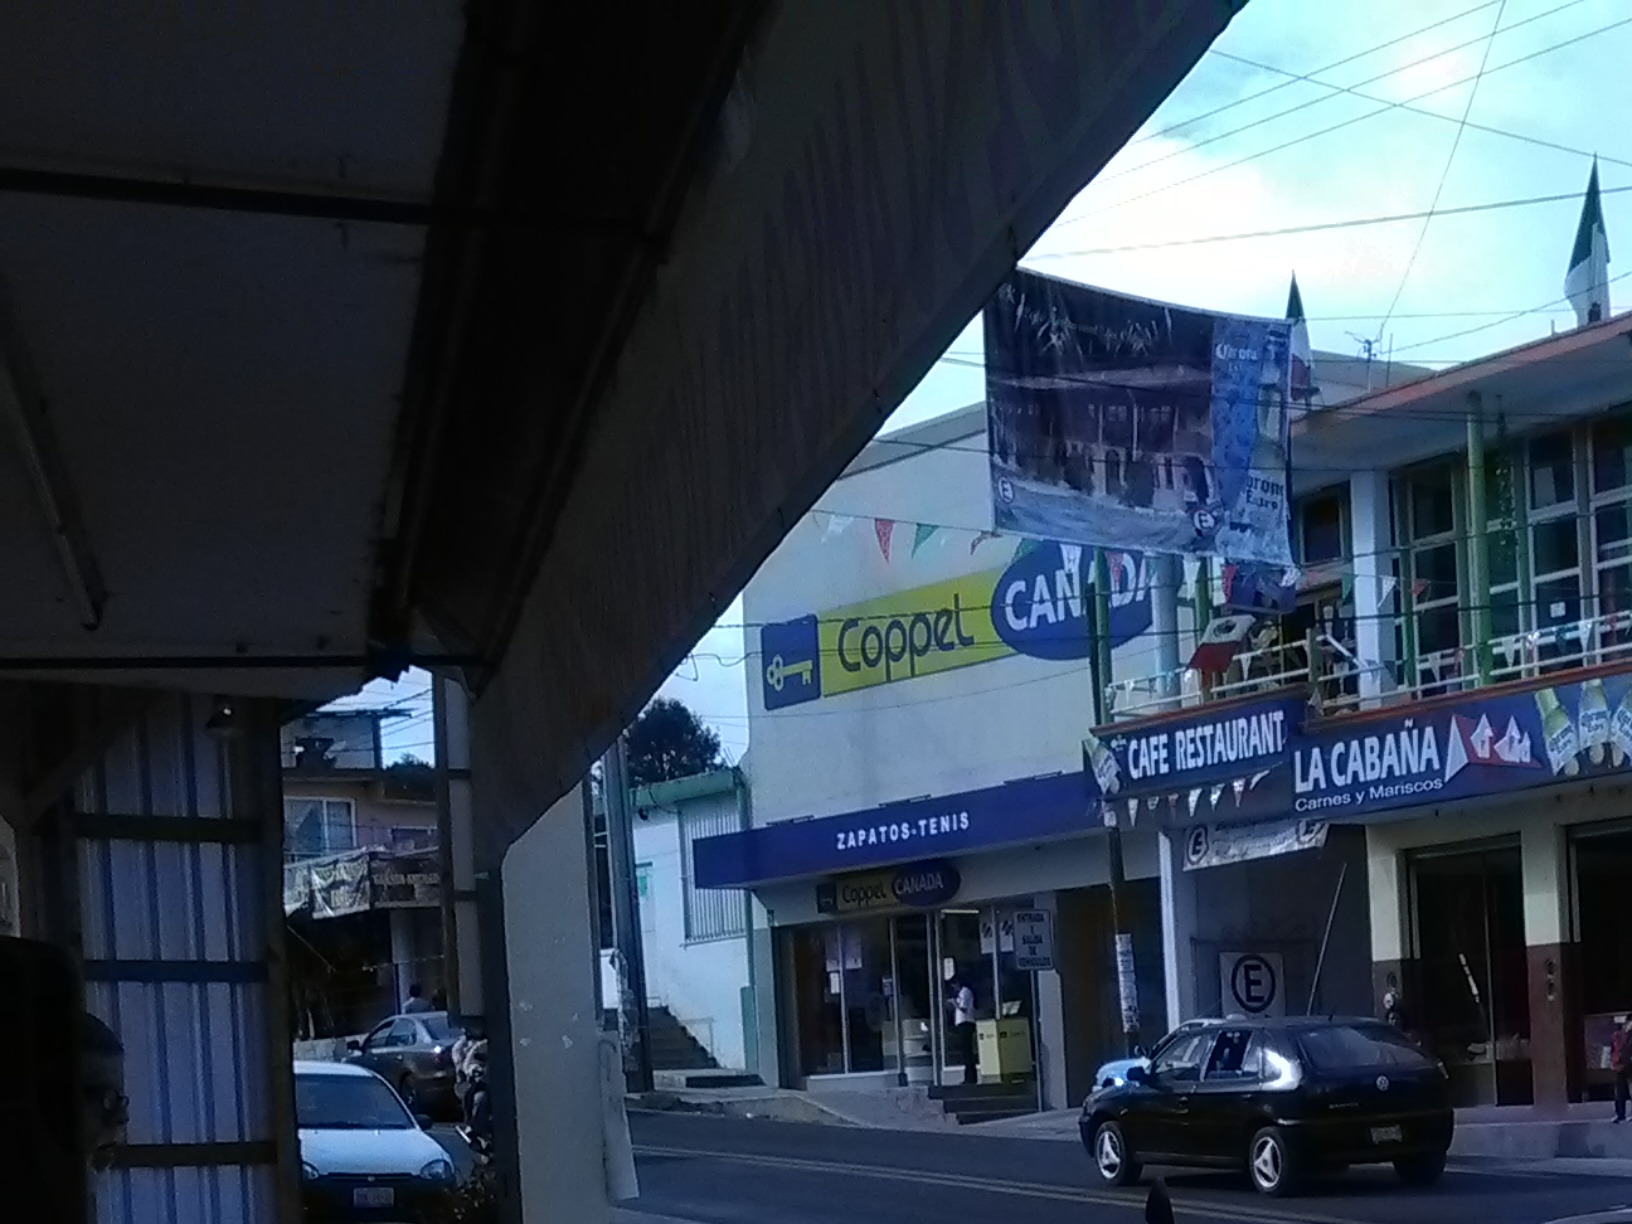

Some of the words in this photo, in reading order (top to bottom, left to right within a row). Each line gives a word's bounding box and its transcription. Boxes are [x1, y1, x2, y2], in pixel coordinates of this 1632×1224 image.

[838, 593, 974, 682] Coppel
[1128, 734, 1169, 781] CAFE
[1175, 710, 1286, 773] RESTAURANT
[1295, 747, 1327, 794] LA
[1330, 718, 1441, 788] CABAÑA
[1295, 791, 1352, 813] Carnes
[1355, 791, 1367, 806] y
[1369, 778, 1444, 801] Mariscos
[836, 811, 970, 850] ZAPATOS-TENIS
[894, 871, 945, 896] CANADA
[1244, 964, 1265, 1003] E
